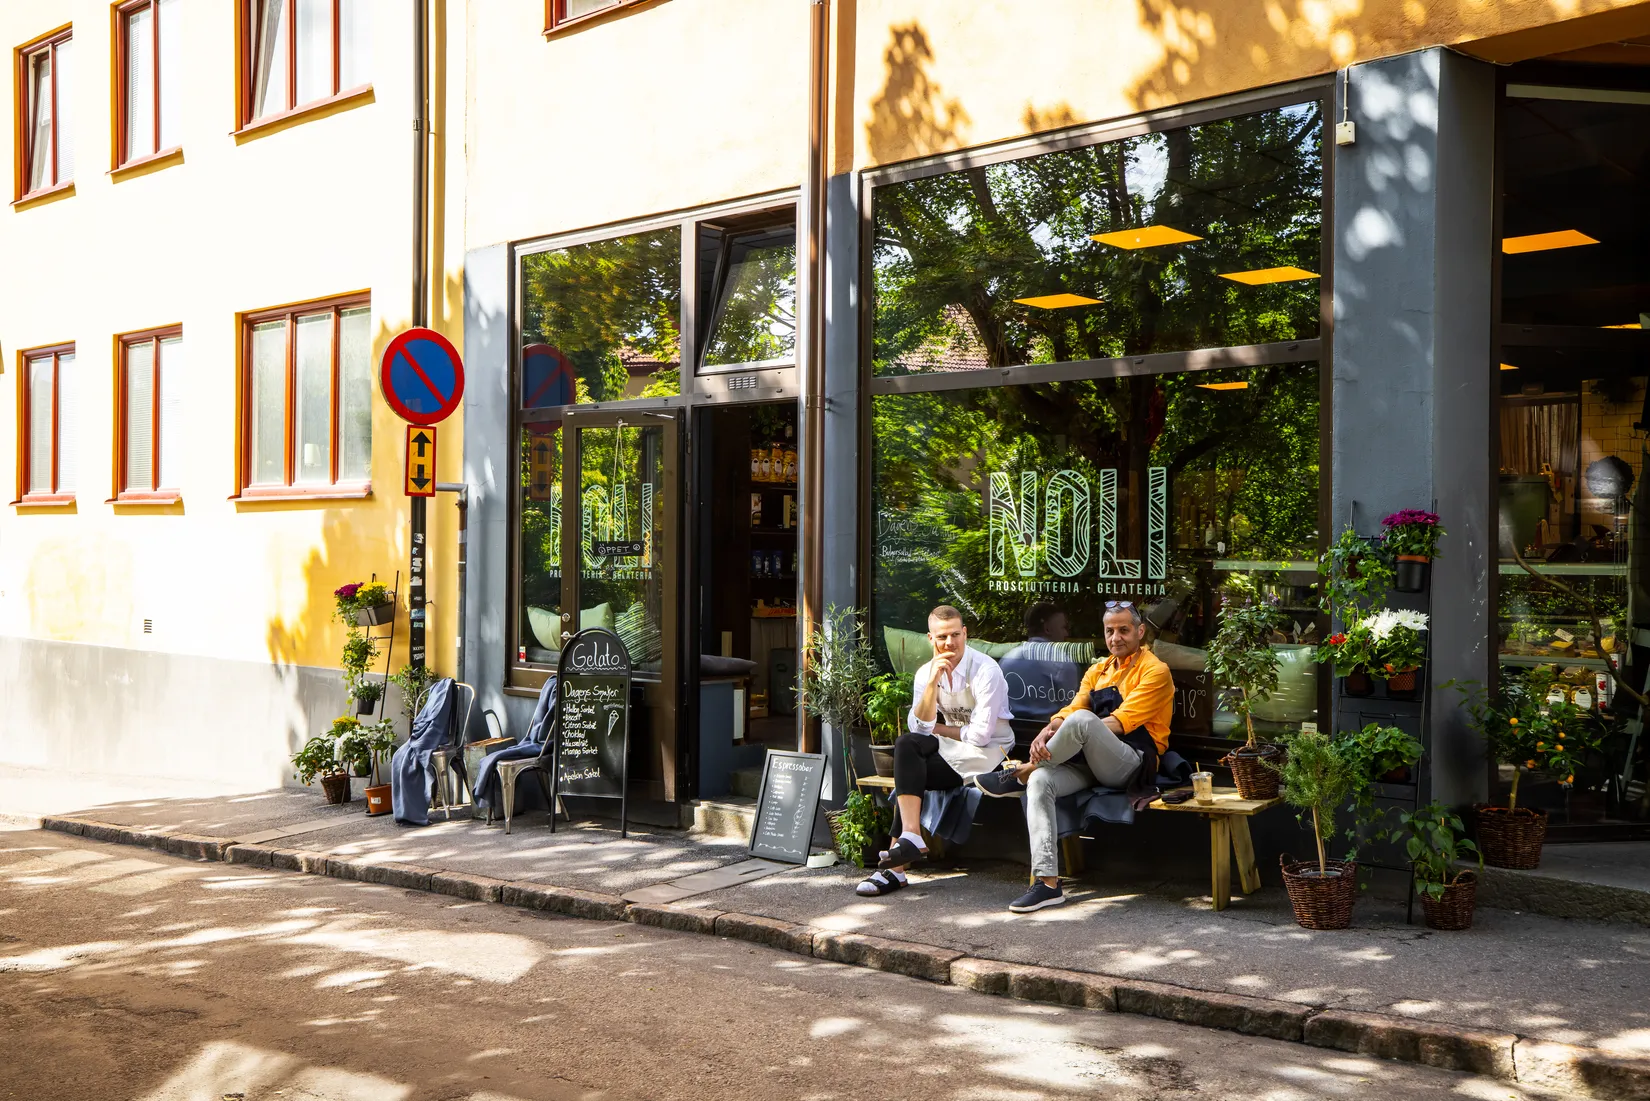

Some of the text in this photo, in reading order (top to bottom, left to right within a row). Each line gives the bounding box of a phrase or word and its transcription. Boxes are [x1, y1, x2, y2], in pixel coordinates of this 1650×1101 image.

[989, 466, 1167, 580] NOLI
[989, 580, 1080, 593] PROSCIUTTERIA
[1097, 582, 1166, 595] GELATERIA
[572, 641, 620, 668] Gelato
[563, 680, 591, 703] Dagens
